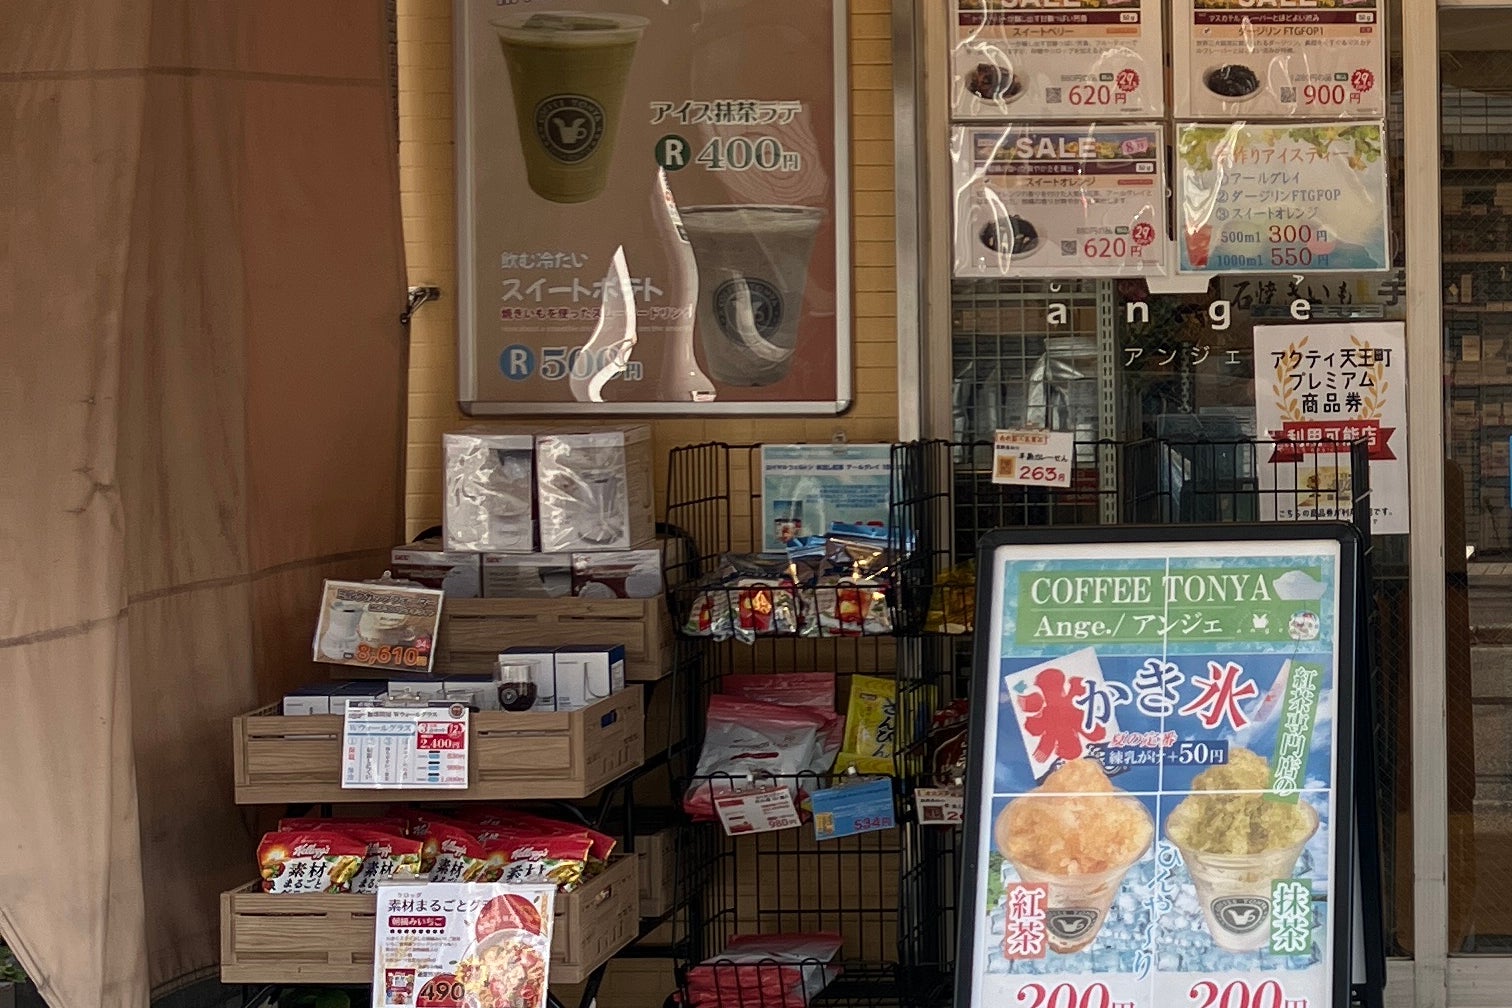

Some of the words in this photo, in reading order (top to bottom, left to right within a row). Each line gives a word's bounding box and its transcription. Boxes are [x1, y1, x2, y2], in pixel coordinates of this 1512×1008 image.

[1013, 27, 1074, 37] スイートベリー
[1068, 85, 1127, 106] 620円
[1303, 85, 1361, 105] 900円
[649, 101, 800, 126] アイス抹茶ラテ
[697, 137, 800, 171] 400円
[1017, 137, 1097, 159] SALE
[1026, 177, 1096, 187] スイートオレンジ
[1084, 237, 1142, 258] 620円
[501, 251, 588, 269] 飲む冷たい
[1124, 345, 1242, 367] アンジェ
[1270, 347, 1393, 369] アクティ天王町
[1288, 371, 1376, 391] プレミアム
[1302, 393, 1364, 415] 商品券
[1019, 466, 1066, 481] 263円
[1031, 575, 1152, 604] COFFEE
[1162, 574, 1272, 602] TONYA
[1132, 612, 1223, 636] アンジェ
[1073, 658, 1259, 731] かき氷
[1273, 666, 1318, 797] 紅茶専門店の
[289, 861, 328, 878] 素材
[283, 878, 321, 889] まるごと
[1007, 884, 1048, 957] 紅茶
[1272, 882, 1312, 952] 抹茶
